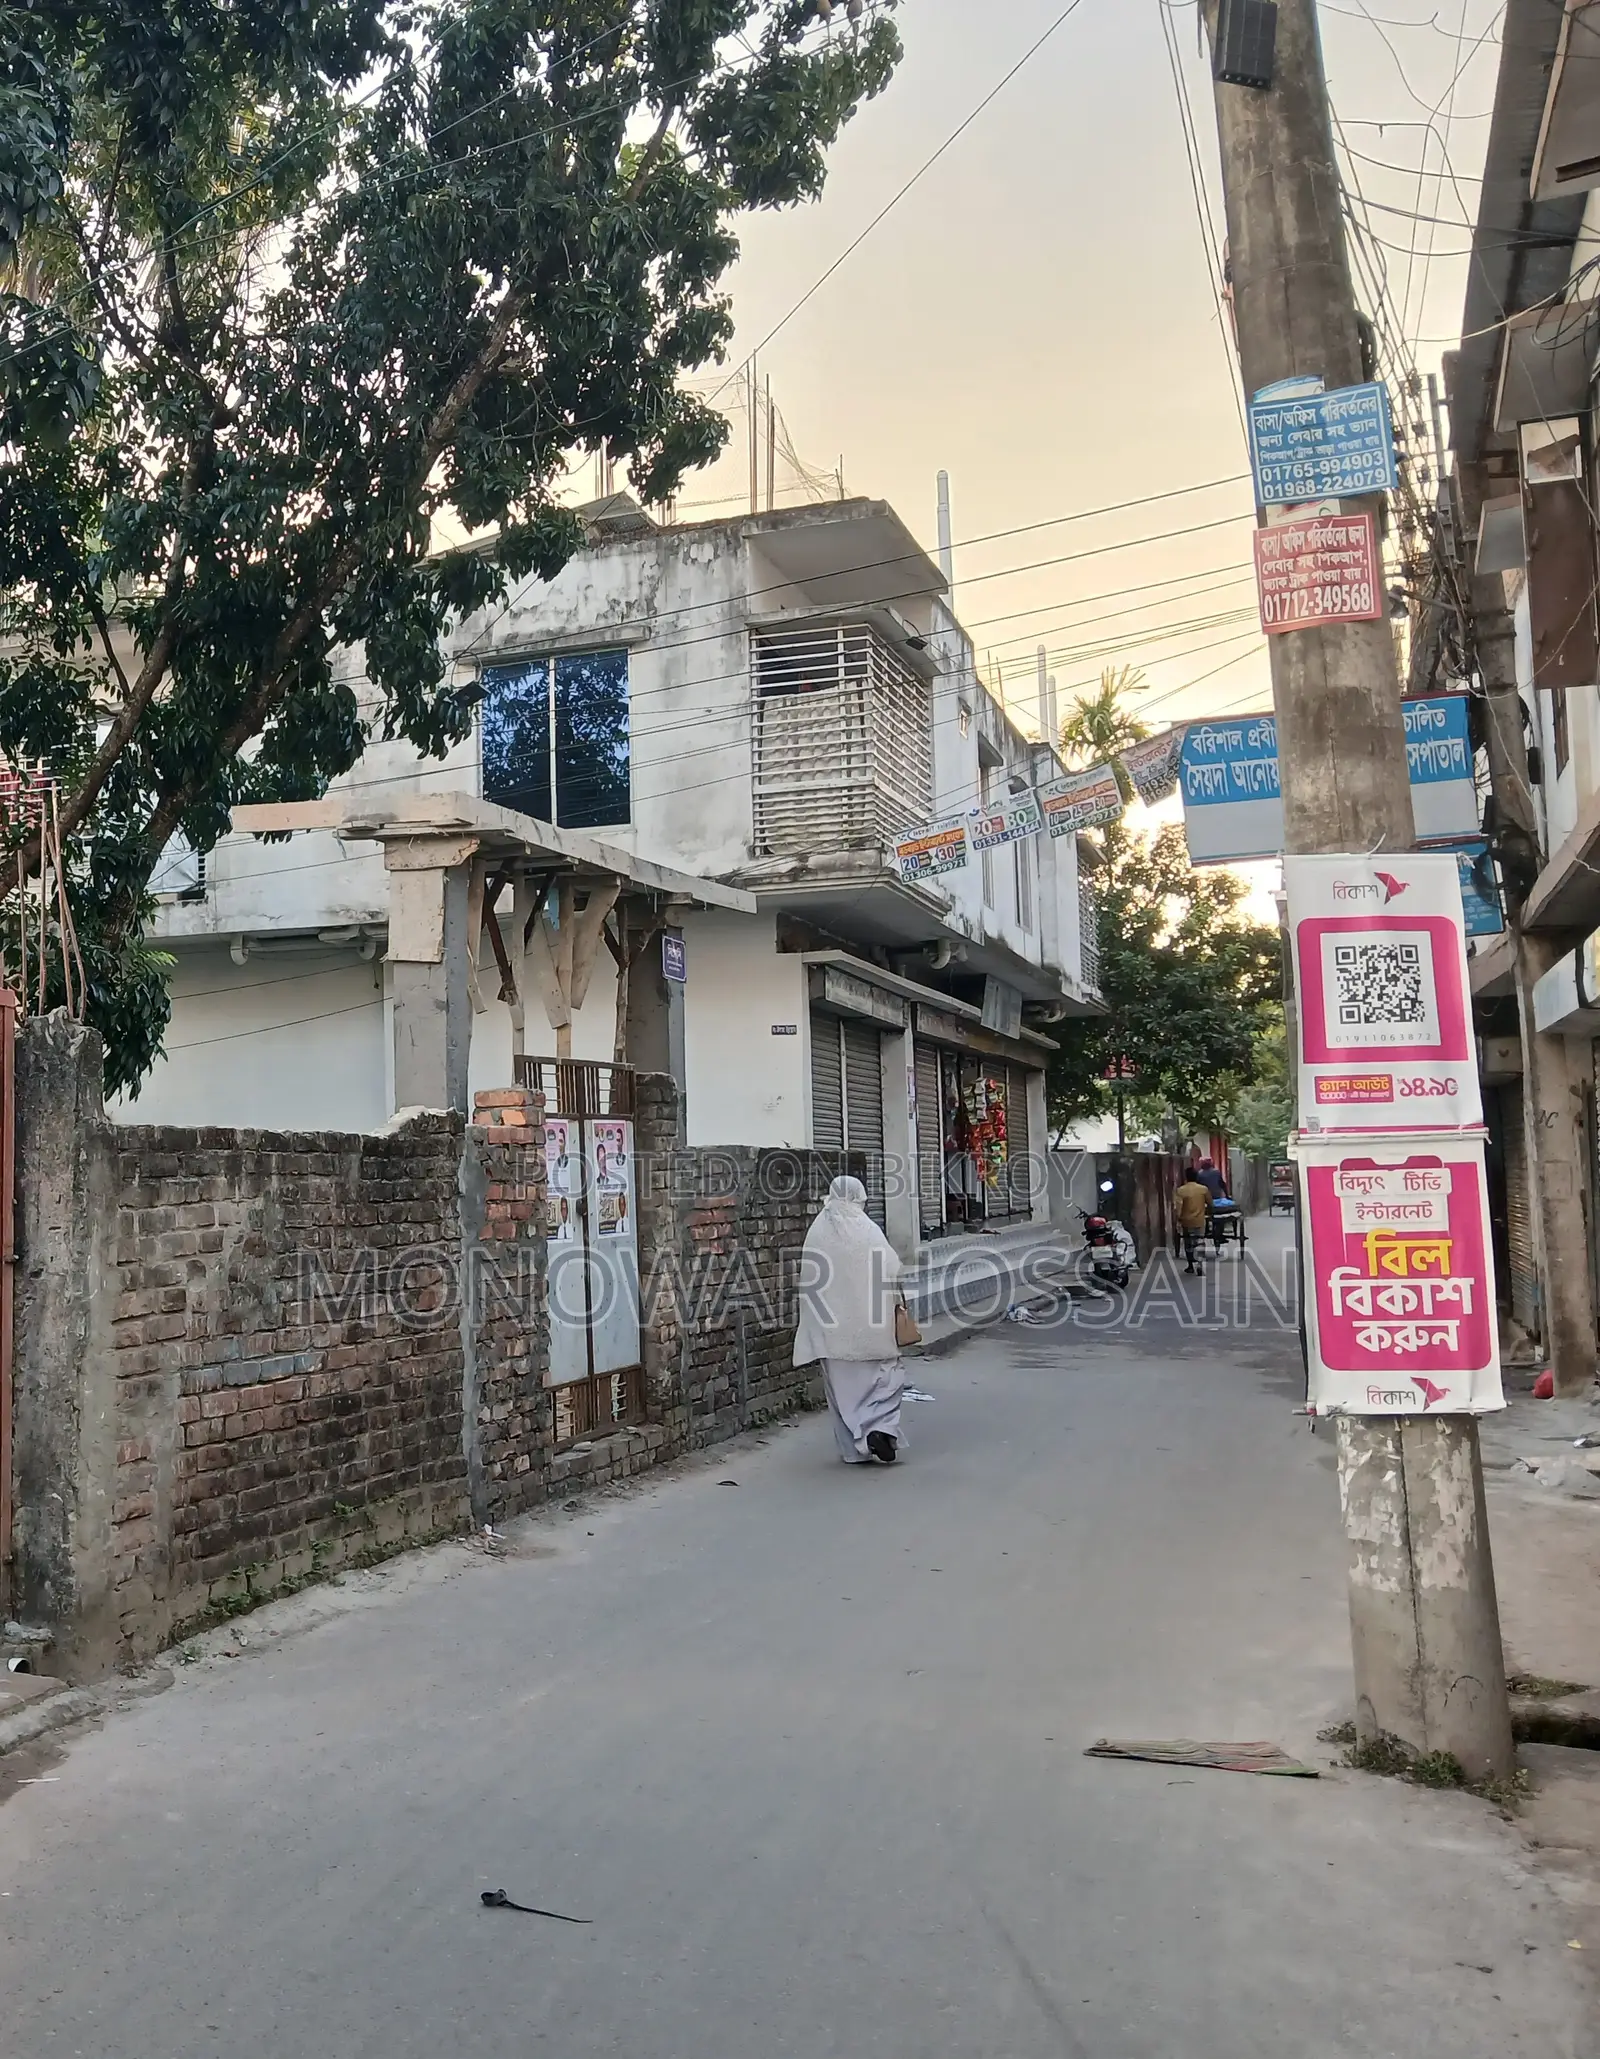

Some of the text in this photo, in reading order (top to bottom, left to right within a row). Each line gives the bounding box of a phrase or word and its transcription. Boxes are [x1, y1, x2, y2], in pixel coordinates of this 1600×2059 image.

[1320, 392, 1377, 422] পরিবর্তনের
[1258, 418, 1377, 448] জন্য লেবার সহ ভ্যান
[1261, 451, 1384, 482] 01765-994903
[1264, 468, 1386, 499] 01968-224079
[1306, 520, 1347, 549] পরিবর্তনের
[1348, 525, 1365, 546] জন্য
[1262, 558, 1295, 575] লেবার
[1296, 554, 1315, 569] সহ
[1311, 568, 1341, 583] পাওয়া
[1263, 582, 1370, 623] 01712-349568
[1190, 725, 1244, 756] বরিশাল
[1247, 719, 1277, 750] প্রবী
[1401, 703, 1447, 734] চালিত
[1182, 755, 1230, 798] সৈয়দা
[1230, 755, 1281, 794] আনোয়
[1405, 735, 1467, 777] সপাতাল
[973, 819, 993, 837] 20
[1051, 807, 1122, 837] 01306-999711
[902, 846, 956, 872] 20 30
[1332, 880, 1379, 900] বিকাশ
[1335, 1033, 1432, 1043] 01911063872
[1318, 1079, 1350, 1092] ক্যাশ
[1351, 1076, 1390, 1090] আউট
[1338, 1171, 1442, 1195] বিদ্যুৎ টিভি
[1355, 1200, 1433, 1220] ইন্টারনেট
[1362, 1227, 1453, 1277] বিল
[1327, 1266, 1475, 1317] বিকাশ
[1352, 1319, 1460, 1355] করুন
[1366, 1384, 1417, 1405] বিকাশ
